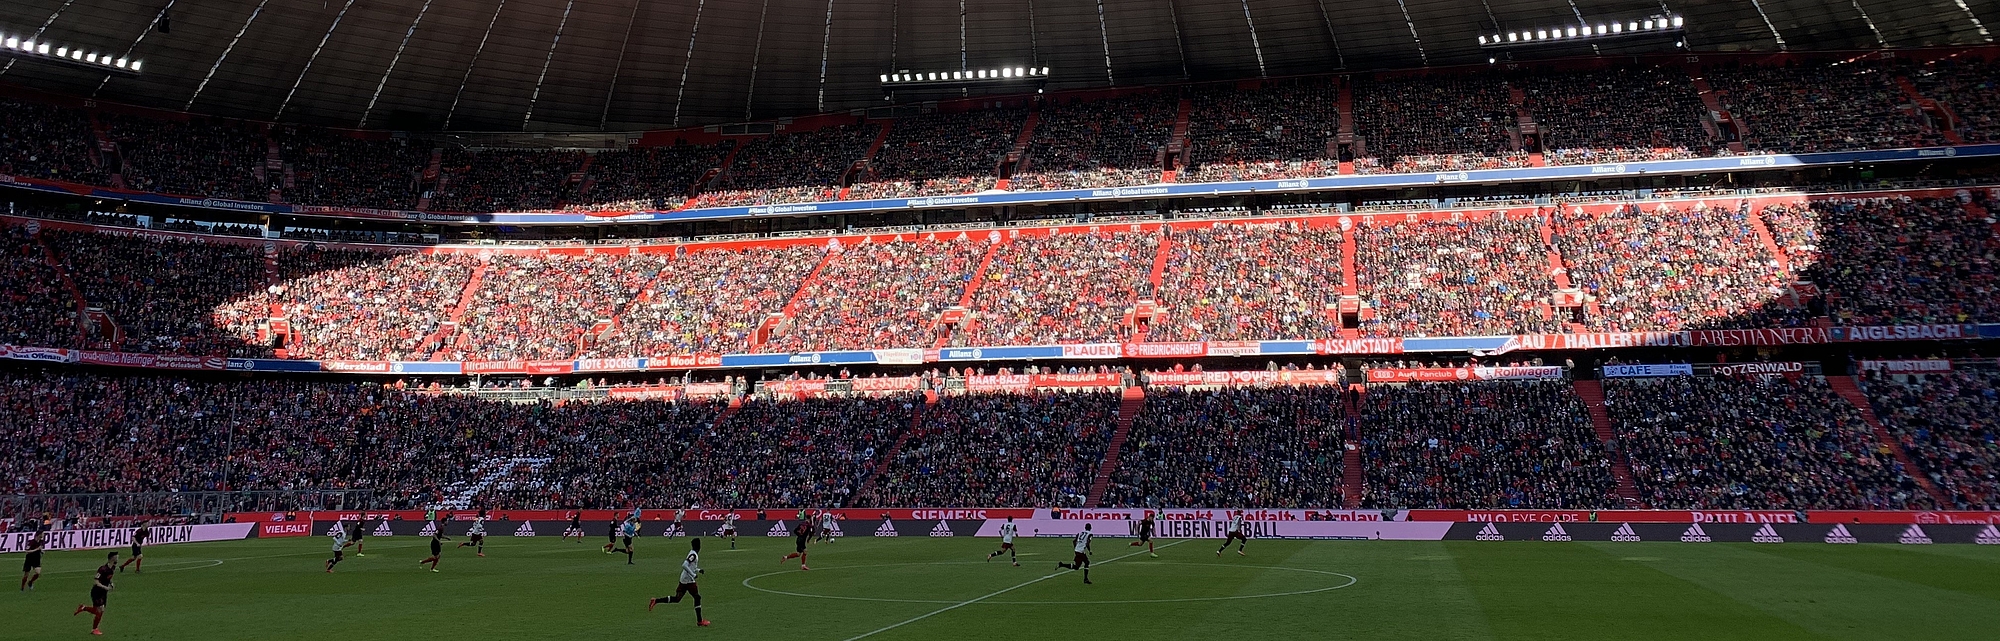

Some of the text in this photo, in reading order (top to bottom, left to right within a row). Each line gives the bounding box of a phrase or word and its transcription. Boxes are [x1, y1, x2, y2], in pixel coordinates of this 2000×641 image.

[1592, 165, 1615, 173] Allianz
[1141, 186, 1168, 194] Investors
[952, 196, 979, 204] Investors
[1689, 328, 1829, 346] LA BESTIA NEGRA
[1851, 324, 1961, 340] AIGLSBACH
[1566, 332, 1669, 347] HALLERTAU
[1065, 345, 1116, 356] PLAUEN
[1139, 343, 1203, 355] FRIEDRICHSHAFEN
[1325, 339, 1396, 353] ASSAMSTADT
[603, 357, 639, 370] SOCKEN
[651, 357, 668, 367] Red
[669, 355, 695, 366] Wood
[698, 353, 720, 364] Cats
[1620, 366, 1651, 374] CAFE
[969, 374, 1030, 385] BAAR-BAZIS
[1207, 371, 1230, 382] RED
[1144, 510, 1213, 520] Rspekt
[265, 524, 308, 534] VIELFALT
[1161, 520, 1211, 538] LIEBEN
[1215, 521, 1280, 538] FUBALL
[16, 530, 77, 551] REPEKT,
[148, 526, 193, 544] AIRPLAY
[1475, 533, 1504, 541] adidas
[1542, 533, 1572, 542] adidas
[1610, 533, 1641, 542] adidas
[1680, 534, 1711, 543] adidas
[1752, 535, 1784, 543] adidas
[1824, 536, 1858, 544] adidas
